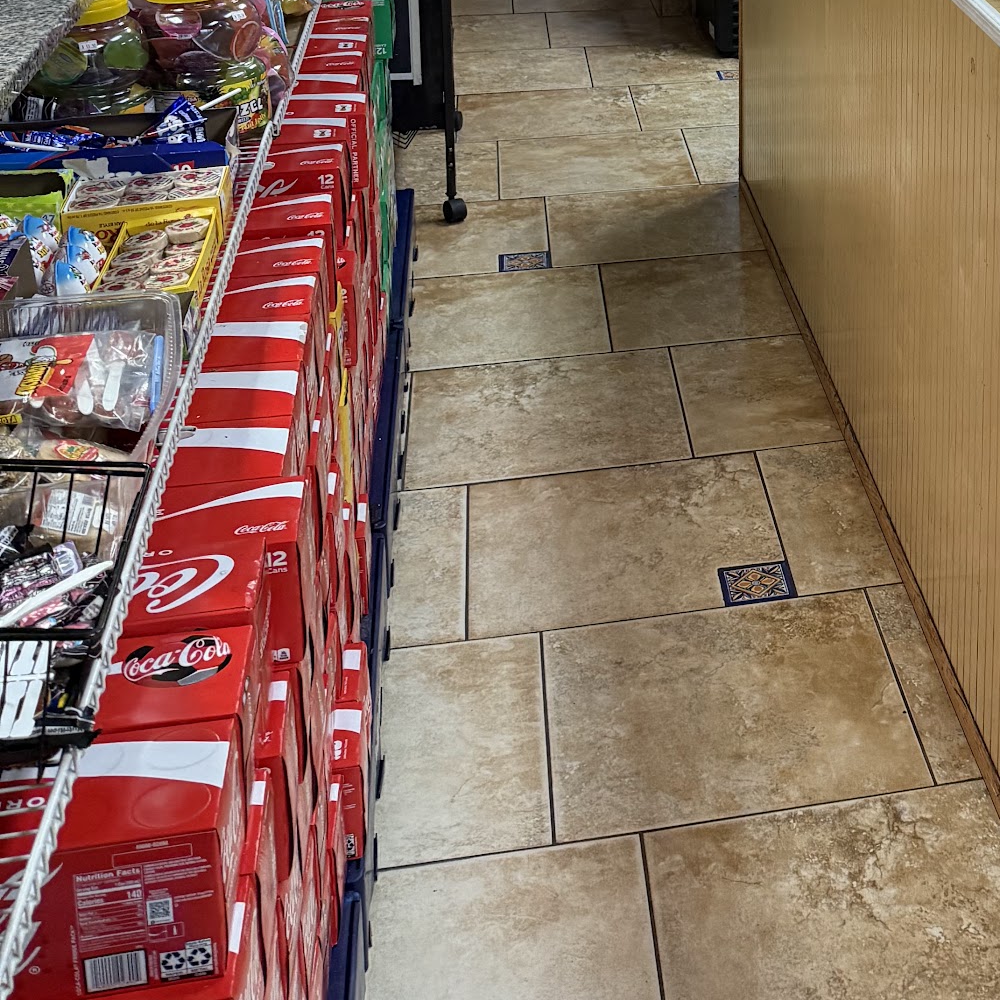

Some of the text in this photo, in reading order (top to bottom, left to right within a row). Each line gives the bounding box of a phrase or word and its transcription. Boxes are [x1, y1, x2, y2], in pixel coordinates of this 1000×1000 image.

[350, 118, 360, 183] OFFICIAL PARTNER
[317, 174, 335, 185] 12
[286, 211, 325, 221] Coca-Cola
[272, 258, 314, 268] Coca-Cola
[262, 298, 305, 309] Coca-Cola
[233, 520, 290, 536] Coca-Cola
[266, 550, 288, 567] 12
[123, 635, 231, 682] Coca-Cola
[76, 869, 114, 883] Nutrition
[116, 867, 141, 877] Facts
[126, 890, 142, 899] 140
